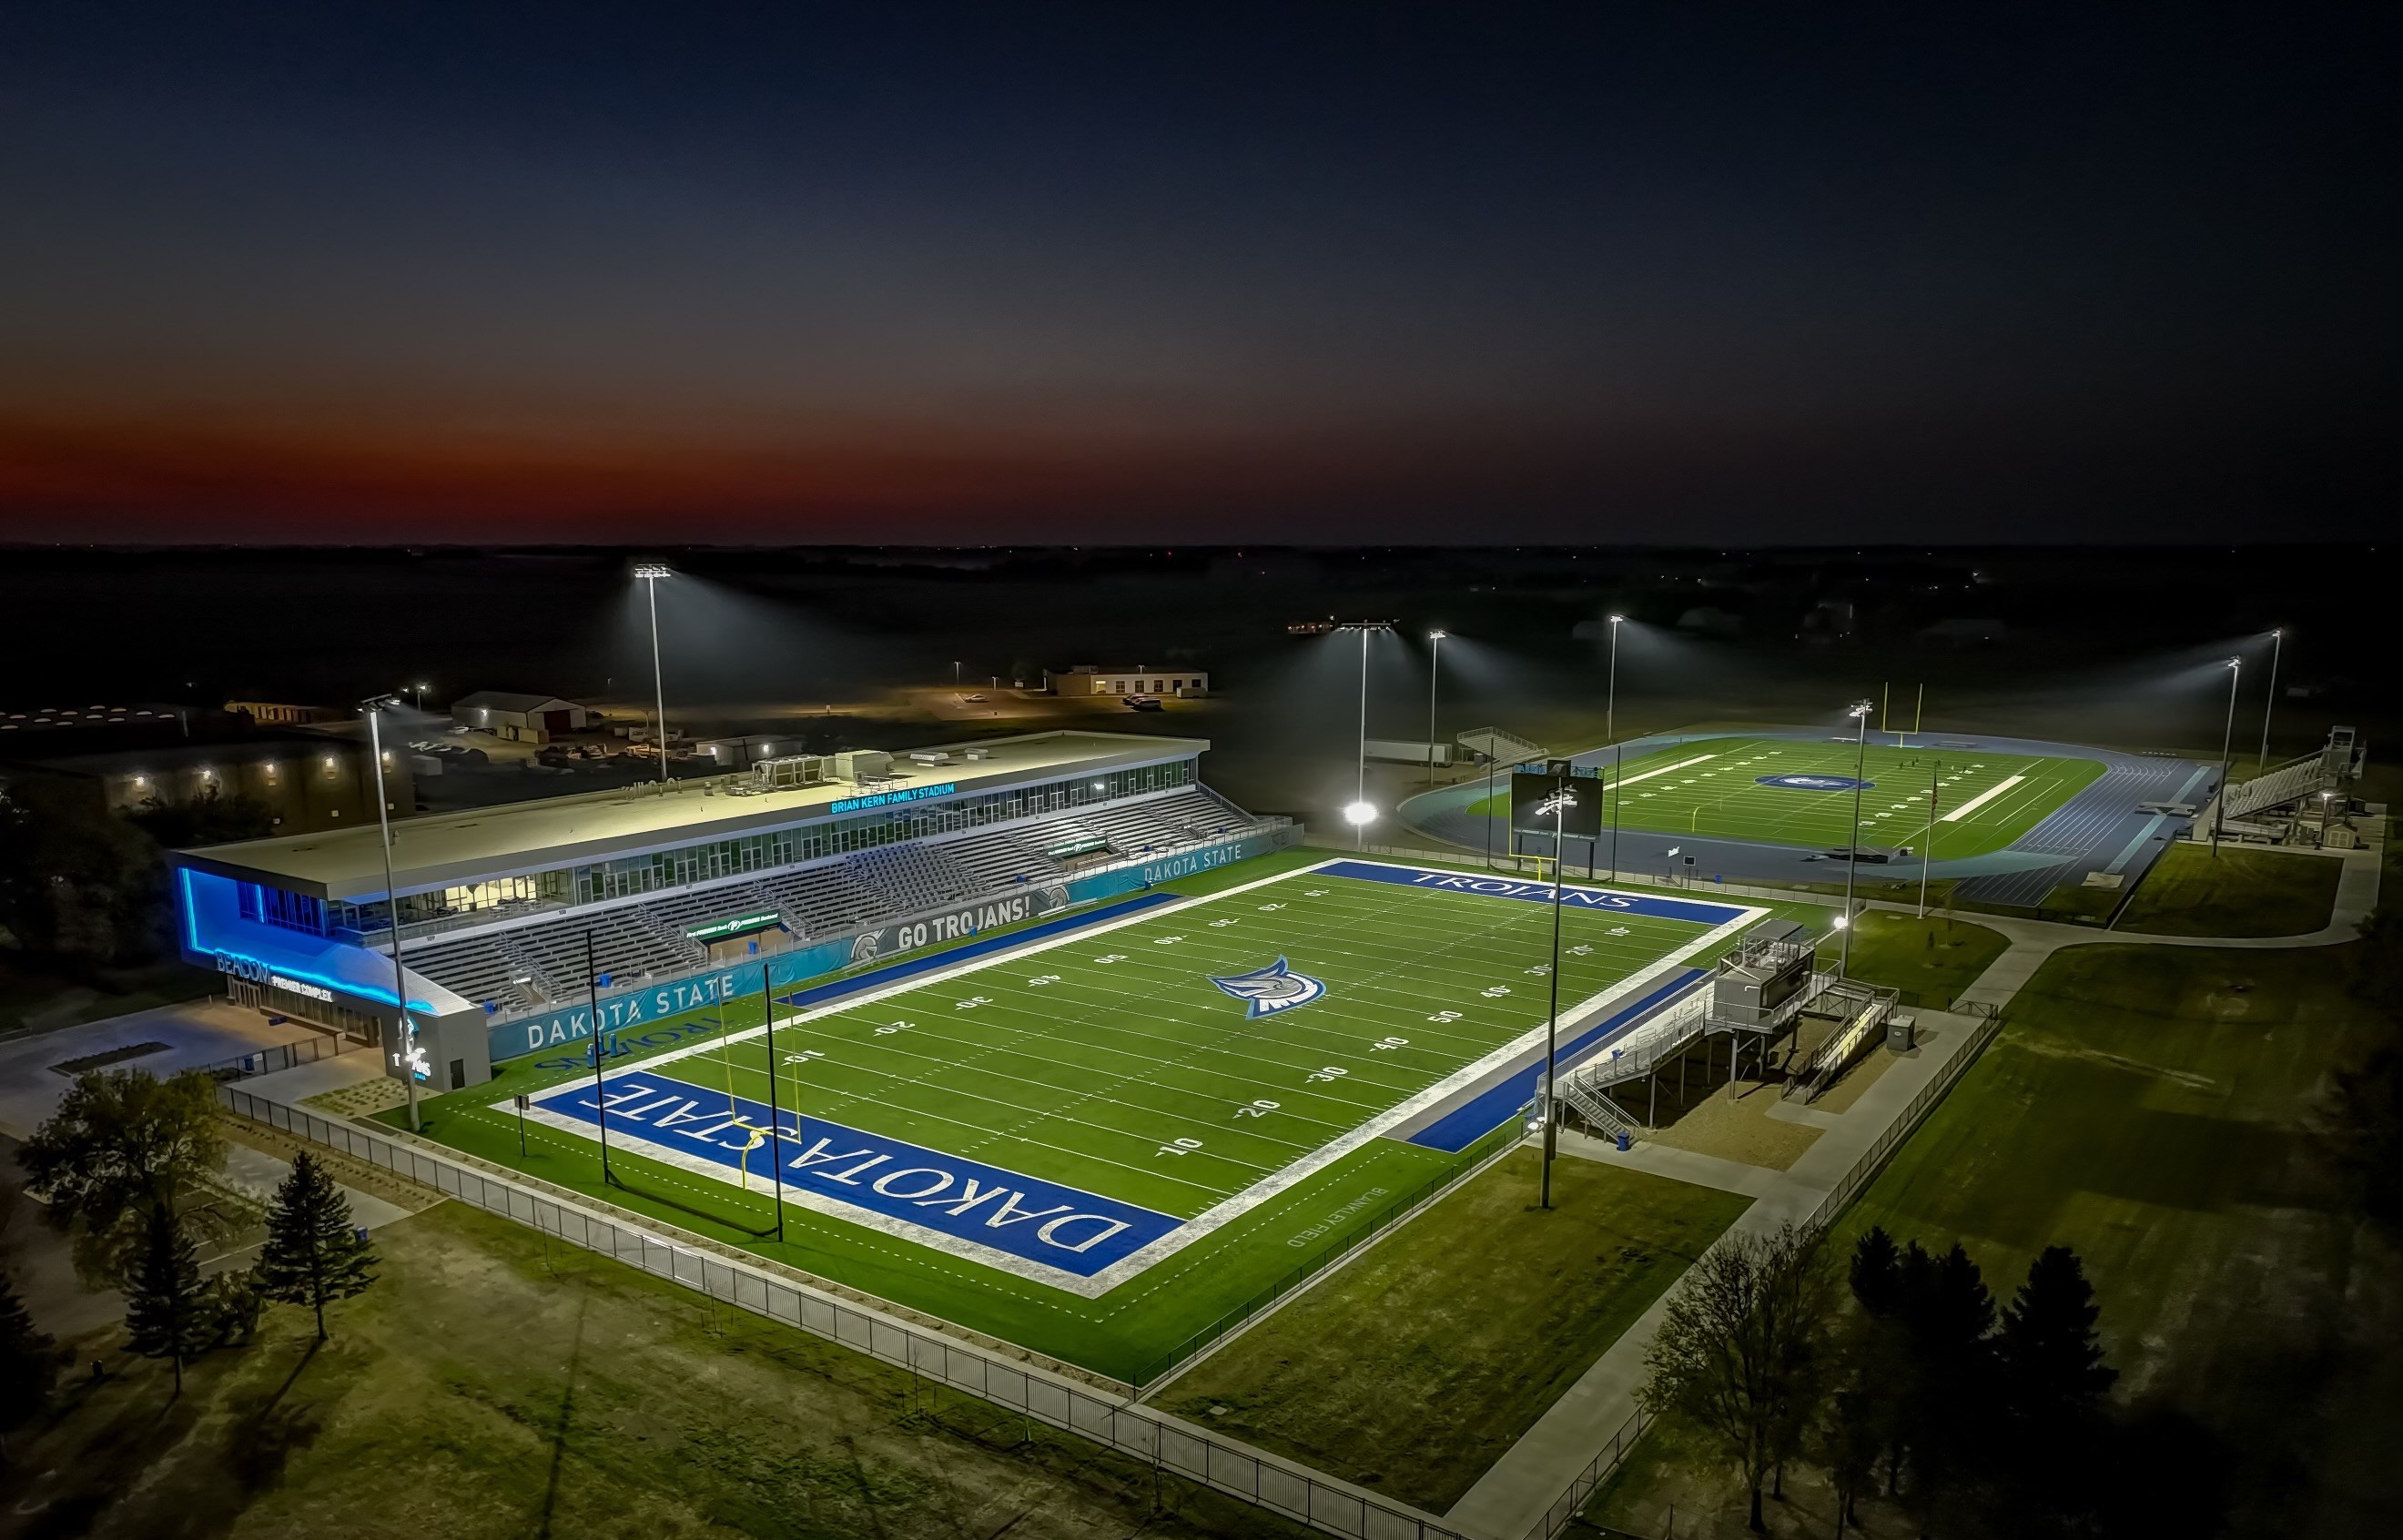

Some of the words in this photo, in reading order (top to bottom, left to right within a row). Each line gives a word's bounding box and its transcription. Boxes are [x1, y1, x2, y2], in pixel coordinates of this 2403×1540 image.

[831, 799, 859, 814] BRIAN
[862, 795, 886, 808] KERN
[887, 789, 918, 804] FAMILY
[919, 784, 955, 799] STADIUM
[1144, 856, 1198, 882] DAKOTA
[1204, 846, 1242, 868] STATE
[1413, 873, 1639, 907] TROJANS
[898, 923, 927, 949] GO
[932, 897, 1030, 941] TROJANS!
[1094, 954, 1128, 964] 50
[1029, 975, 1061, 986] 40
[1481, 987, 1512, 998] 40
[528, 999, 642, 1049] DAKOTA
[656, 974, 735, 1014] STATE
[956, 997, 994, 1008] 30
[1427, 1011, 1464, 1023] 50
[875, 1020, 916, 1035] 20
[1374, 1037, 1410, 1050] 40
[785, 1049, 826, 1063] 10
[1309, 1067, 1349, 1082] 30
[578, 1084, 798, 1150] STATE
[1238, 1100, 1281, 1118] 20
[1161, 1138, 1203, 1156] 10
[788, 1138, 1132, 1253] DAKOTA
[1323, 1187, 1389, 1226] BLANKLEY
[1287, 1223, 1331, 1248] FIELD
